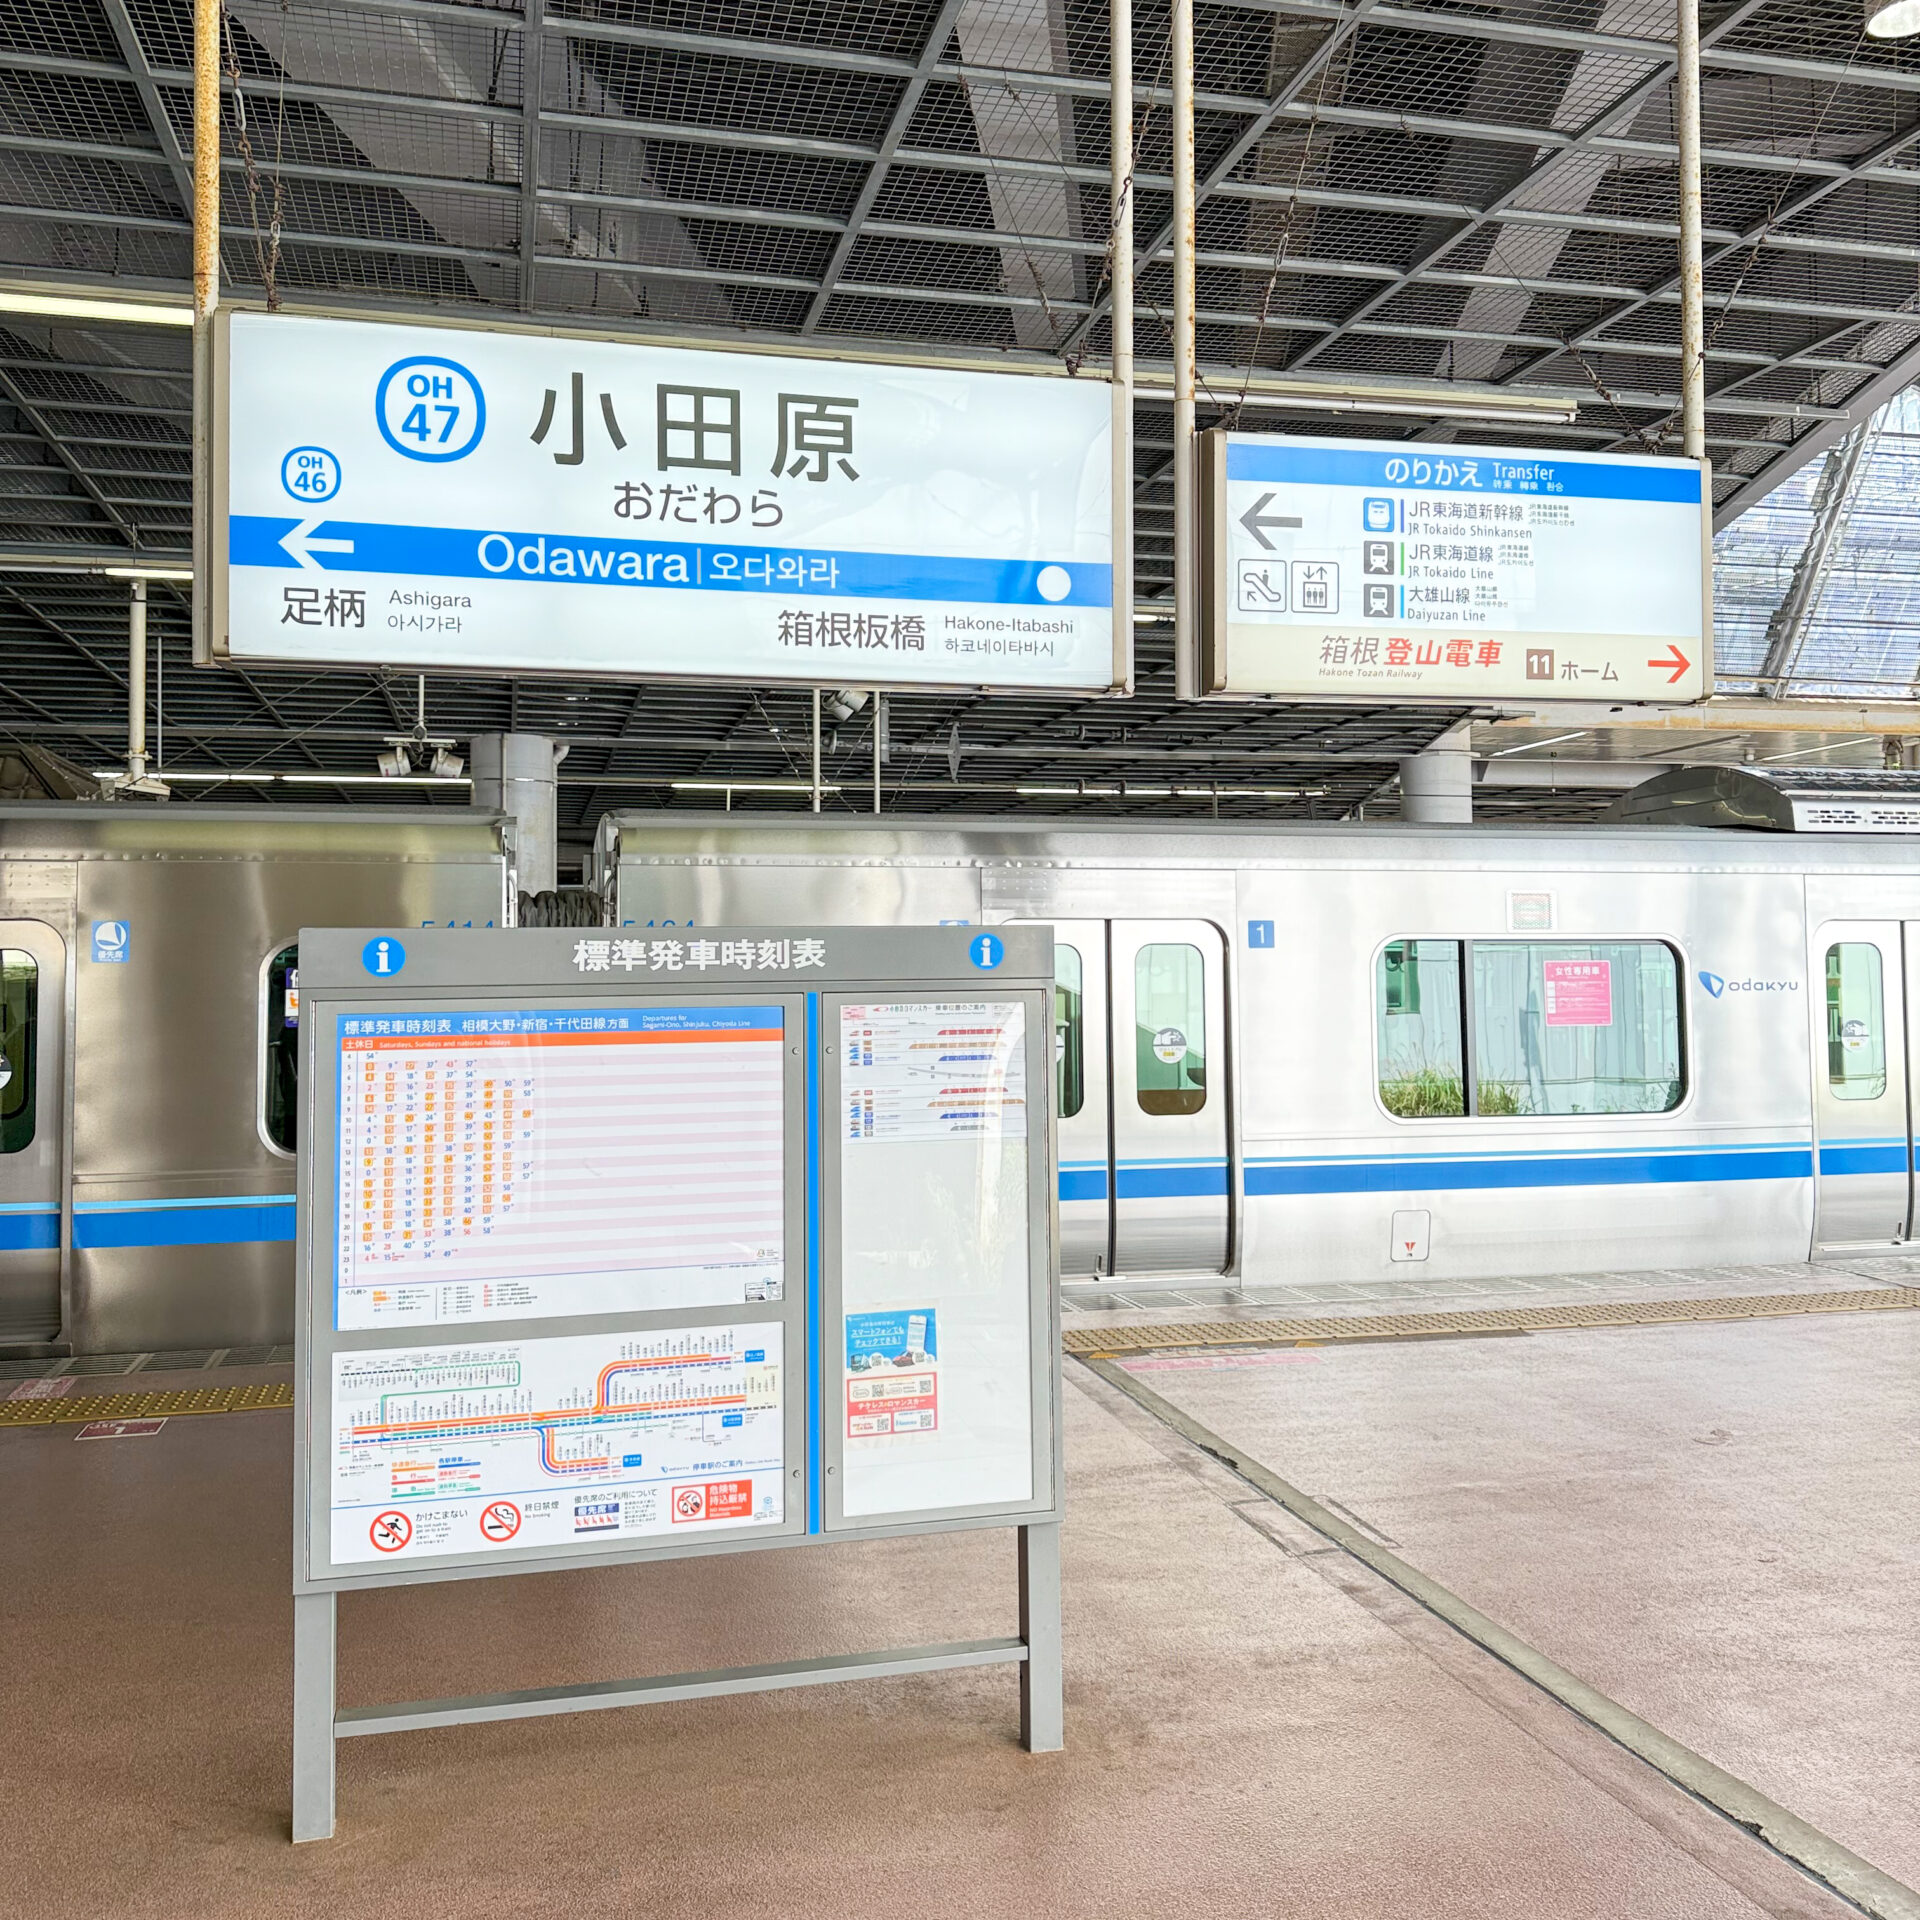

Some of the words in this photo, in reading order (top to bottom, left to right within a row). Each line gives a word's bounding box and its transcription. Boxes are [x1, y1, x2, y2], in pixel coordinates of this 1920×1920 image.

[407, 374, 453, 399] OH
[401, 403, 460, 443] 47
[530, 372, 860, 483] 小田原
[297, 455, 323, 470] OH
[1385, 458, 1483, 487] のりかえ
[1492, 462, 1555, 480] Transfer
[294, 472, 327, 493] 46
[613, 481, 784, 528] おだわら
[1409, 501, 1524, 522] JR東海道新幹線
[1408, 523, 1419, 536] JR
[1424, 523, 1466, 536] Tokaido
[1470, 525, 1532, 539] Shinkansen
[477, 533, 690, 583] Odawara
[1409, 544, 1494, 563] JR東海道線
[709, 552, 840, 589] 오다와라
[1408, 566, 1419, 579] JR
[1424, 566, 1466, 579] Tokaido
[1471, 567, 1494, 580] Line
[388, 589, 472, 611] Ashigara
[1409, 585, 1470, 605] 大雄山線
[281, 586, 365, 628] 足柄
[1407, 608, 1458, 623] Daiyuzan
[1463, 609, 1486, 622] Line
[387, 614, 462, 634] 아시가라
[778, 610, 926, 652] 箱根板橋
[944, 615, 1074, 635] Hakone-Itabashi
[944, 637, 1055, 658] 하코네이타바시
[1319, 634, 1504, 668] 箱根登山電車
[1318, 667, 1354, 678] Hakone
[1357, 668, 1384, 679] Tozan
[1386, 668, 1423, 680] Railway
[1529, 654, 1551, 675] 11
[1561, 660, 1620, 682] ホーム
[1256, 923, 1265, 945] 1
[572, 938, 826, 972] 標準発車時刻表
[1728, 978, 1798, 991] odakyu
[344, 1019, 451, 1035] 標準発車時刻表
[462, 1017, 629, 1033] 相模大野・新宿・千代田線方面
[346, 1039, 374, 1050] 土休日
[415, 1509, 468, 1522] かけこまない
